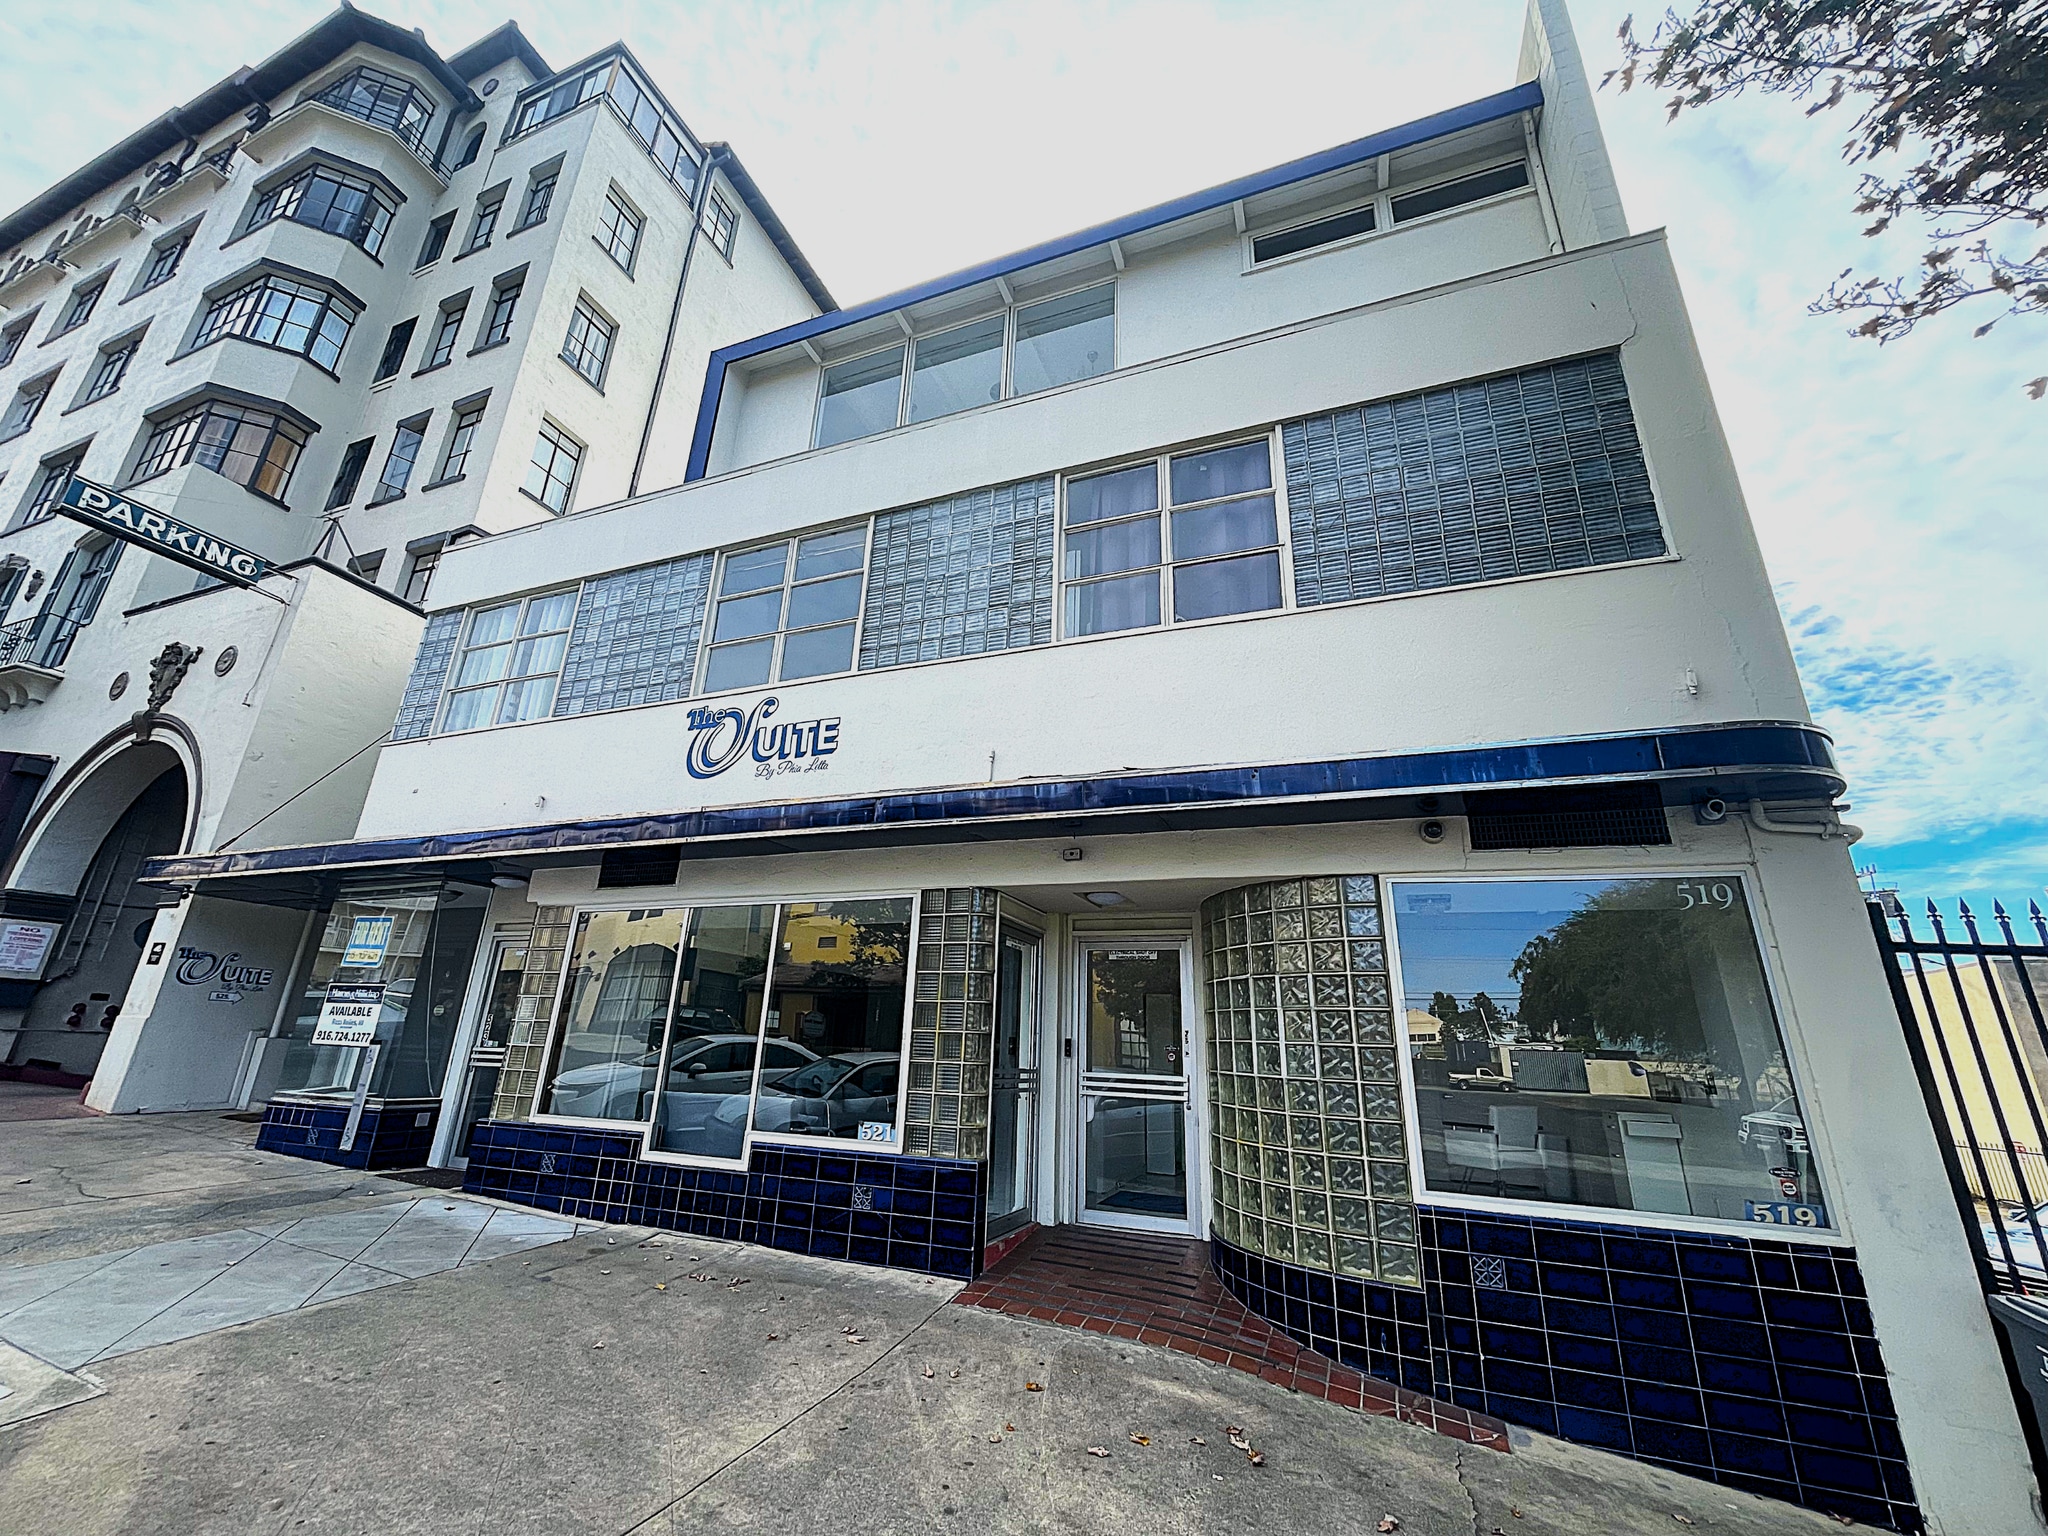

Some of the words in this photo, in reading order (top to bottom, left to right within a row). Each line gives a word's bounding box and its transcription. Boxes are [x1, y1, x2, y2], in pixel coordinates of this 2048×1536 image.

[77, 486, 258, 577] PARKING
[686, 705, 727, 732] The
[754, 762, 775, 781] By
[1676, 881, 1734, 911] 519
[328, 1005, 373, 1017] AVAILABLE
[315, 1030, 372, 1043] 916.724.1277
[861, 1124, 893, 1143] 521
[1752, 1203, 1818, 1228] 519
